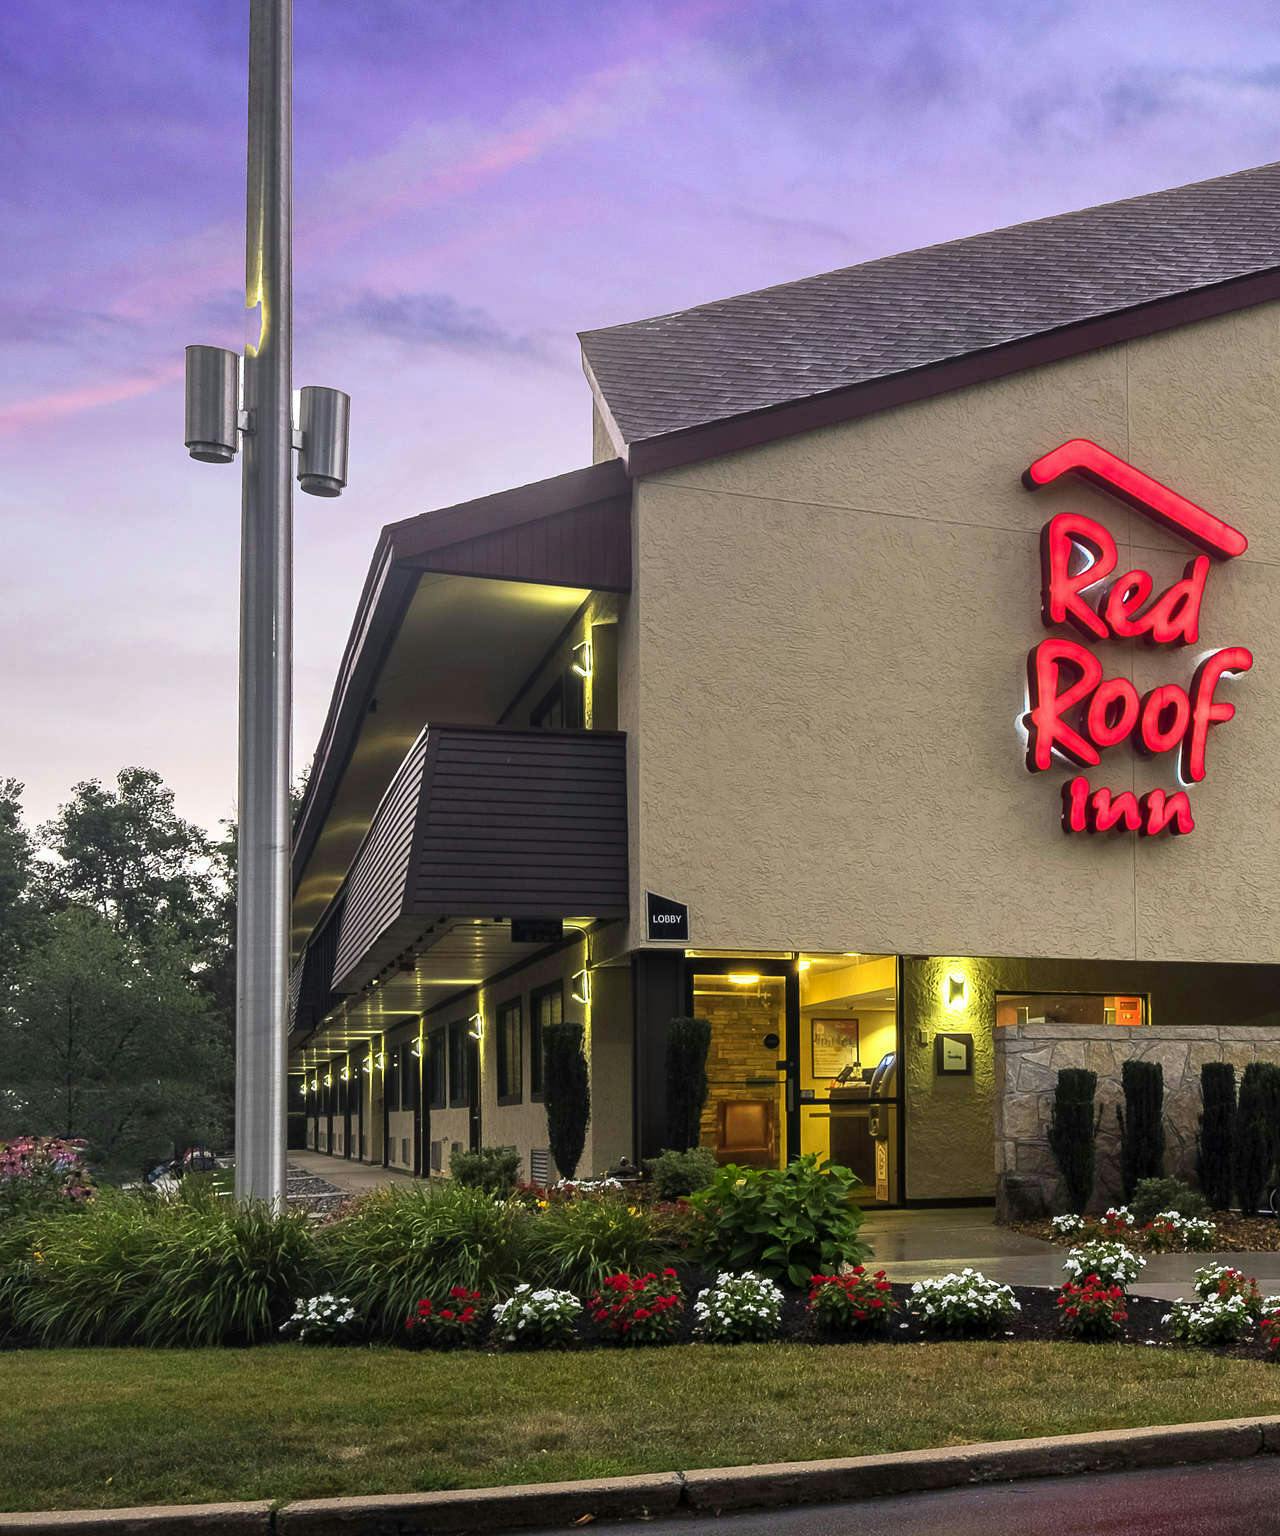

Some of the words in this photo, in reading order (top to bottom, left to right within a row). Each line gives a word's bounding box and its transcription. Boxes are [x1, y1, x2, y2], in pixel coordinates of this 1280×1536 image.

[1041, 512, 1210, 645] Red
[1027, 638, 1253, 784] Roof
[1062, 776, 1195, 835] Inn
[652, 914, 682, 924] LOBBY
